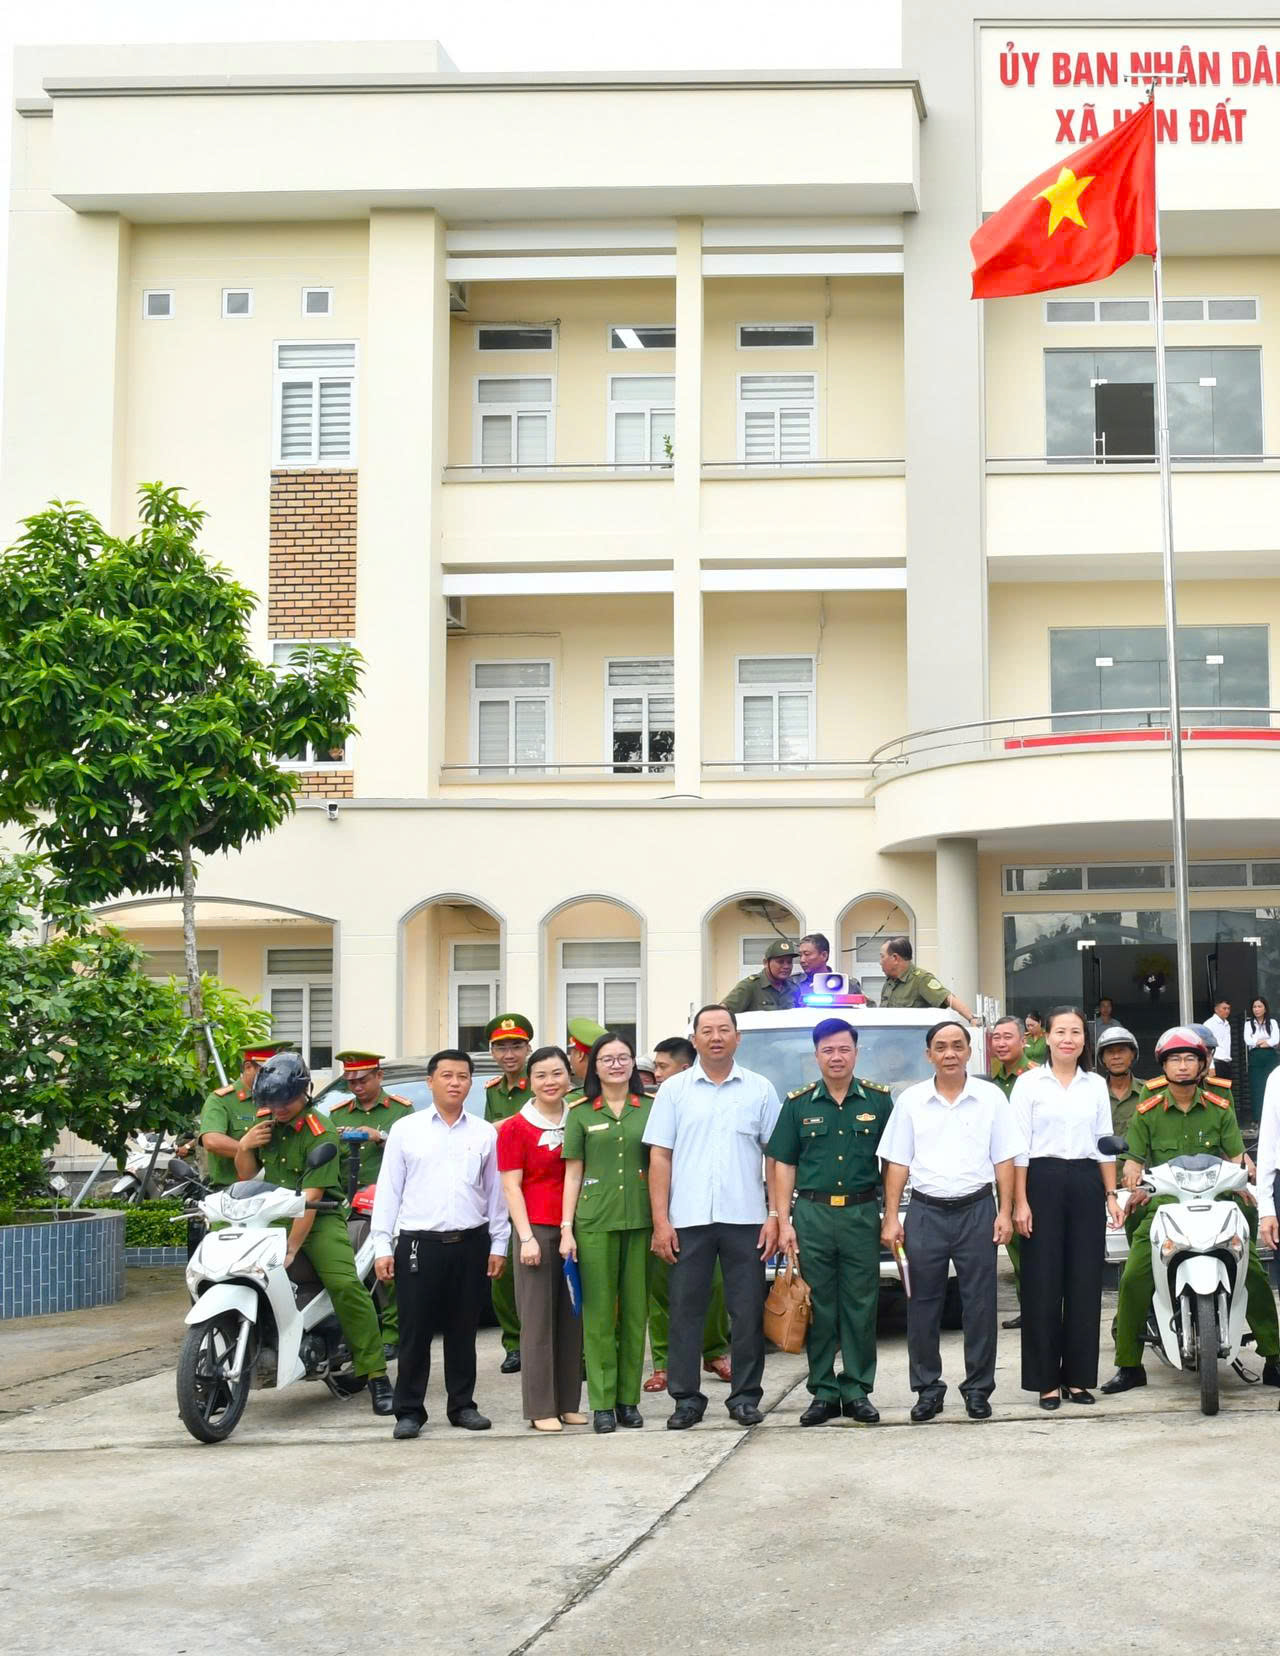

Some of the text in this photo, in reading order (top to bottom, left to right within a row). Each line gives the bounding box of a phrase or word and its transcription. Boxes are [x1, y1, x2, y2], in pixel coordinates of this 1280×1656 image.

[1000, 41, 1040, 86] ỦY
[1052, 52, 1118, 86] BAN
[1130, 45, 1220, 86] NHÂN
[1055, 103, 1099, 144] XÃ
[1189, 98, 1247, 144] ĐẤT
